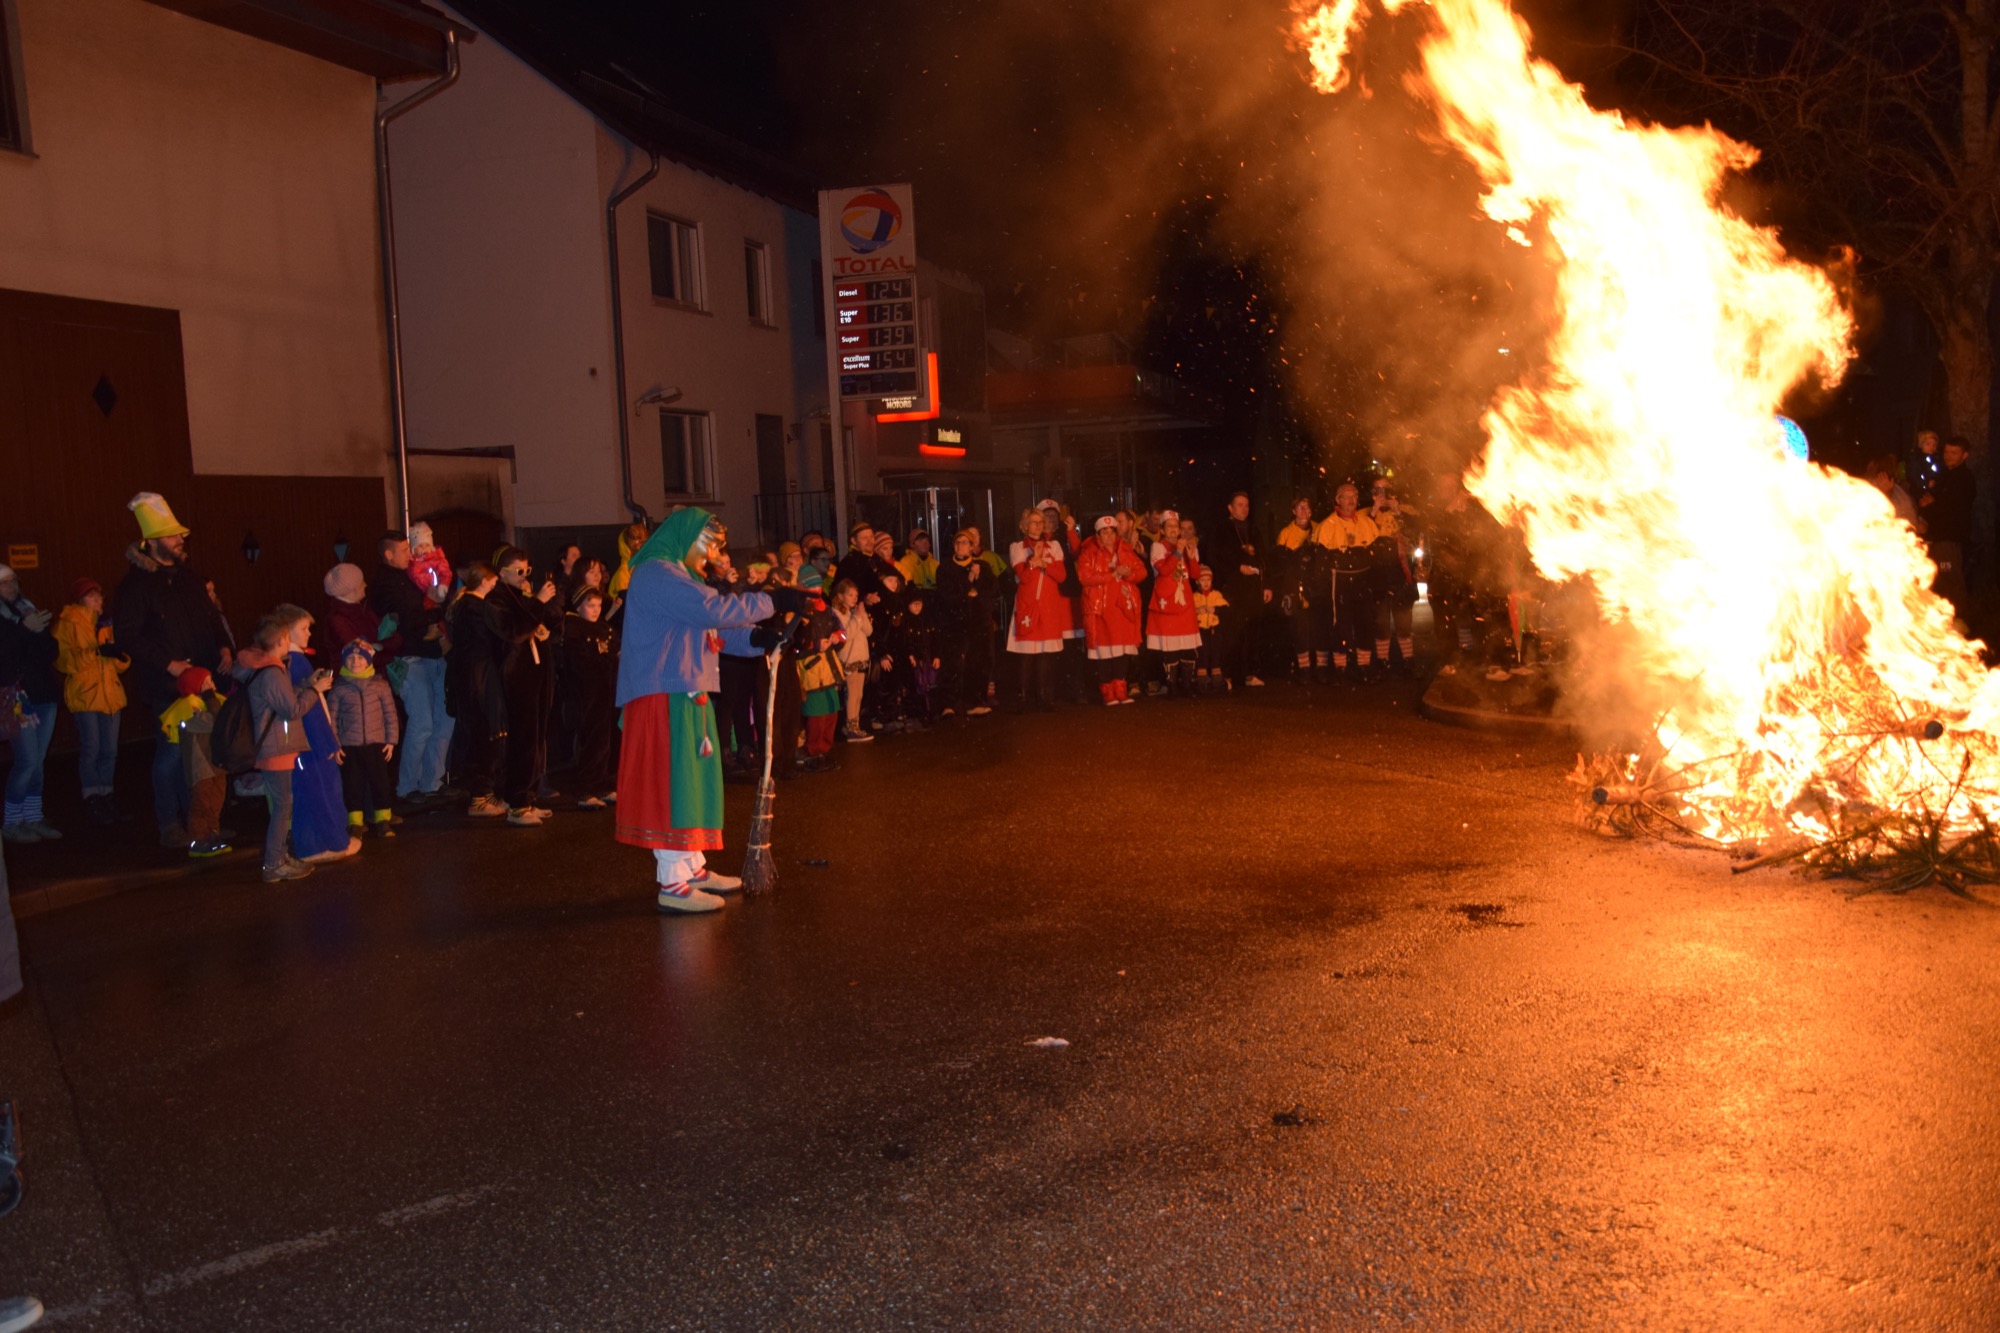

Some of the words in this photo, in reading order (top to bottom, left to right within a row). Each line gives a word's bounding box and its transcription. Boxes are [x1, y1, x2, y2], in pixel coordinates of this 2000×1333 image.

[834, 256, 913, 274] TOTAL
[838, 289, 858, 297] Diesel
[840, 309, 858, 318] Super
[841, 336, 860, 344] Super
